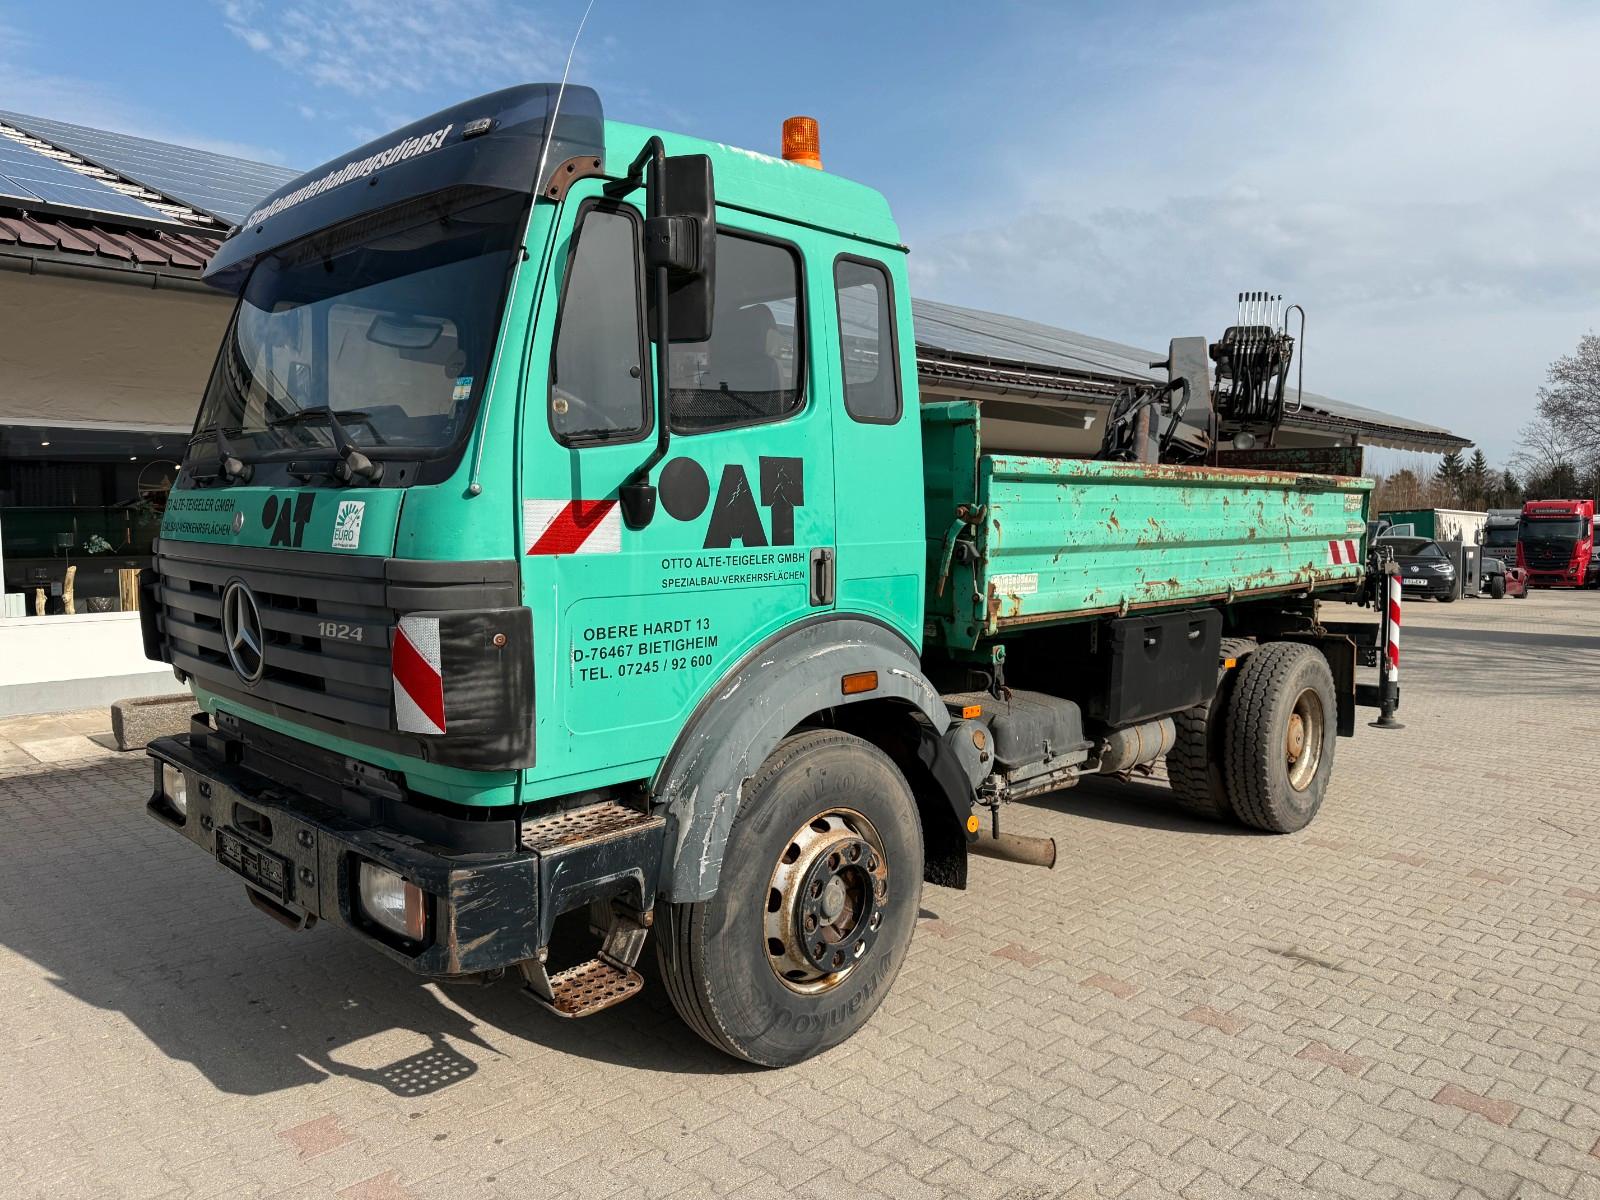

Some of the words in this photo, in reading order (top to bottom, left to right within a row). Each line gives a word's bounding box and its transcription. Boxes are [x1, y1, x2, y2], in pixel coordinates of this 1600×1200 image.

[242, 123, 454, 233] Straßenunterhaltungsdienst
[172, 499, 213, 512] ALTE-TEIGELER
[214, 499, 236, 513] GMBH
[658, 456, 804, 549] OAT
[262, 492, 316, 548] OAT
[334, 529, 354, 542] EURO
[661, 557, 693, 570] OTTO
[695, 554, 775, 568] ALTE-TEIGELER
[777, 552, 805, 564] GMBH
[661, 570, 805, 589] SPEZIALBAU-VERKEHRSFLÄCHEN
[318, 622, 363, 642] 1824
[583, 624, 638, 642] OBERE
[643, 619, 692, 636] HARDT
[696, 617, 710, 631] 13
[573, 644, 633, 663] D-76467
[638, 635, 718, 655] BIETIGHEIM
[579, 667, 613, 682] TEL.
[618, 661, 660, 677] 07245
[662, 659, 668, 671] /
[671, 657, 687, 671] 92
[690, 653, 713, 667] 600
[769, 972, 879, 1036] Hankoo
